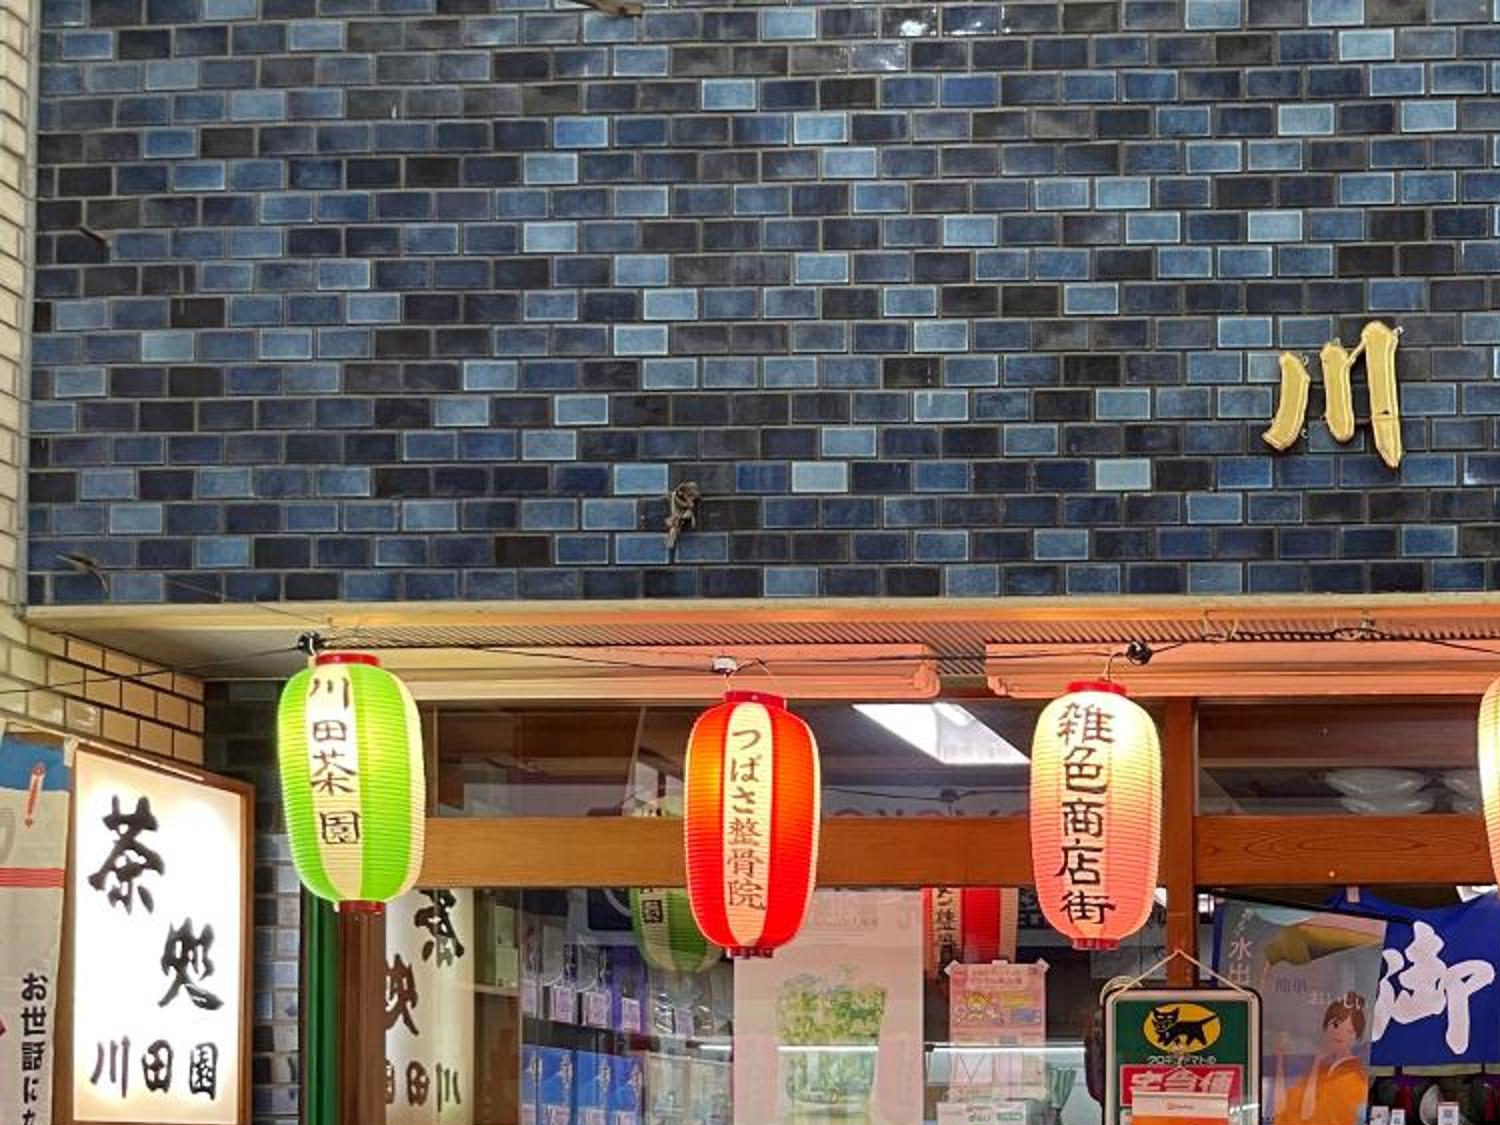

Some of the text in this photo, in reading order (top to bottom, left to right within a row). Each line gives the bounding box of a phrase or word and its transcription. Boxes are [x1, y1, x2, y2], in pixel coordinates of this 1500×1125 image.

[310, 677, 361, 846] 川田茶園
[727, 727, 766, 912] つばさ整骨院
[1057, 701, 1117, 926] 雑色商店街
[90, 1034, 219, 1102] 川田園
